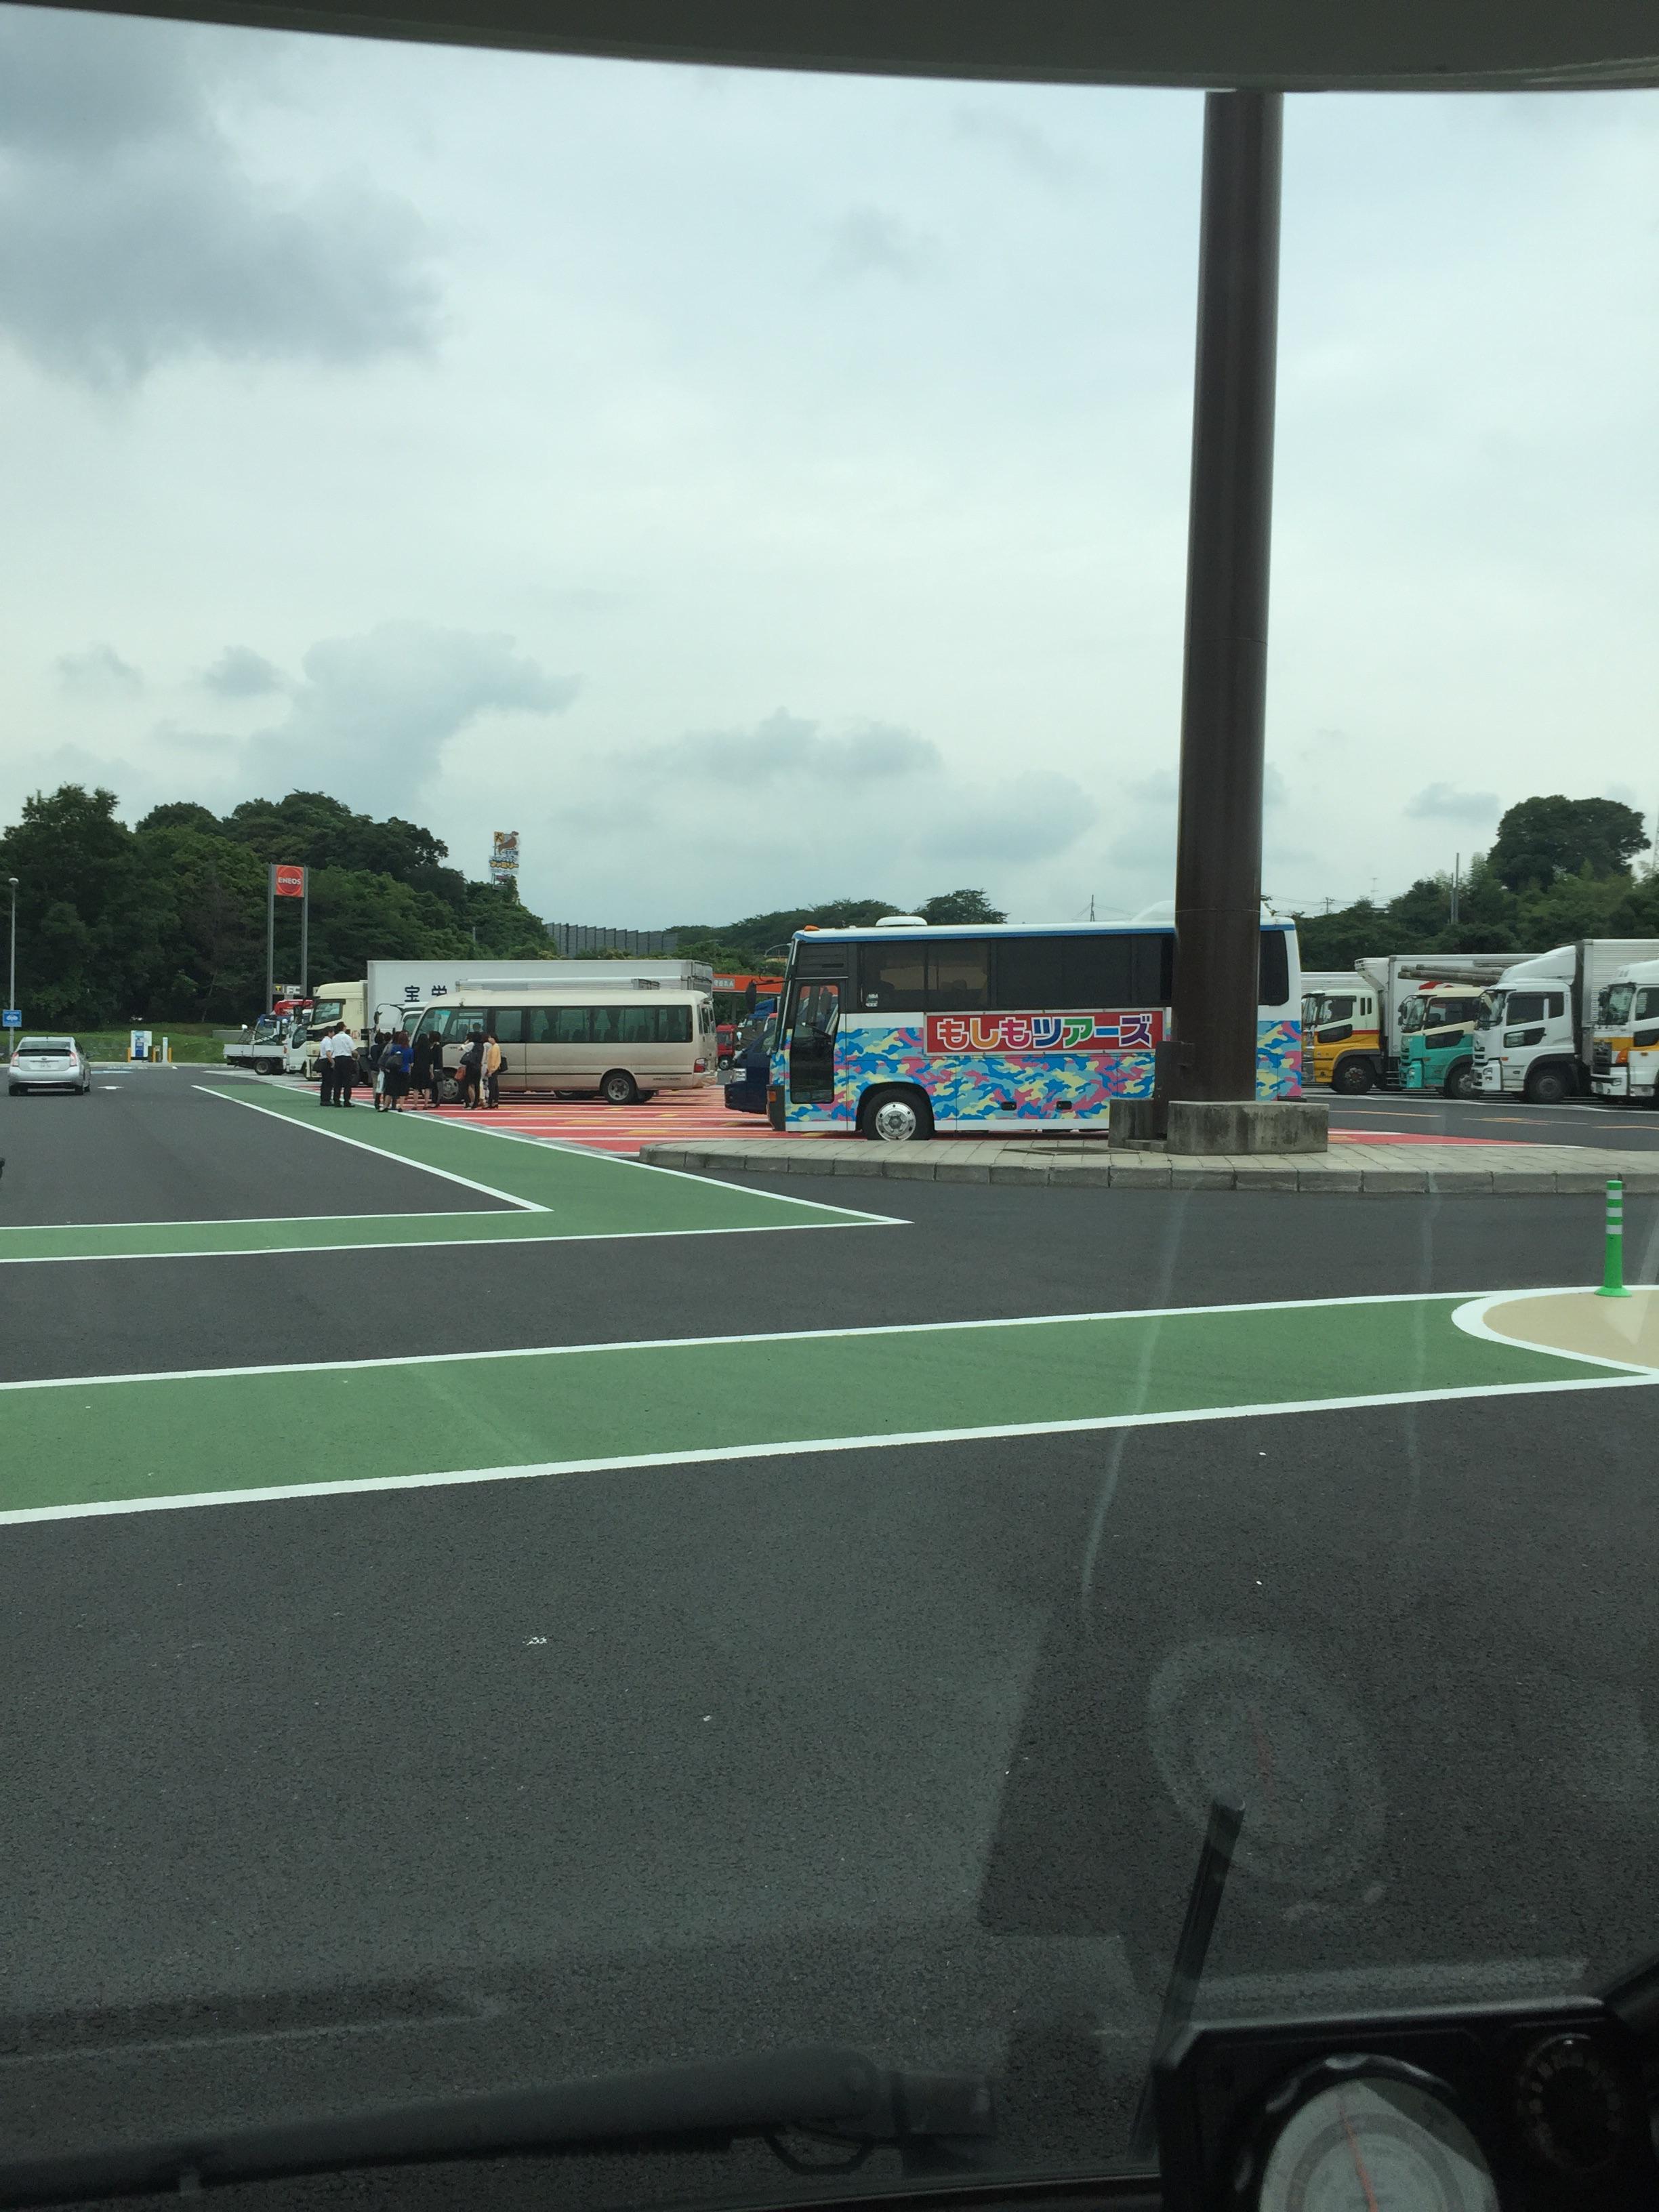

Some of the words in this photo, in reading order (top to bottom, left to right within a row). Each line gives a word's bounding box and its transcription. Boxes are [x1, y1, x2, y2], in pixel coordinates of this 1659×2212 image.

[278, 877, 302, 885] ENEOS
[937, 1014, 1152, 1050] もしもツアーズ
